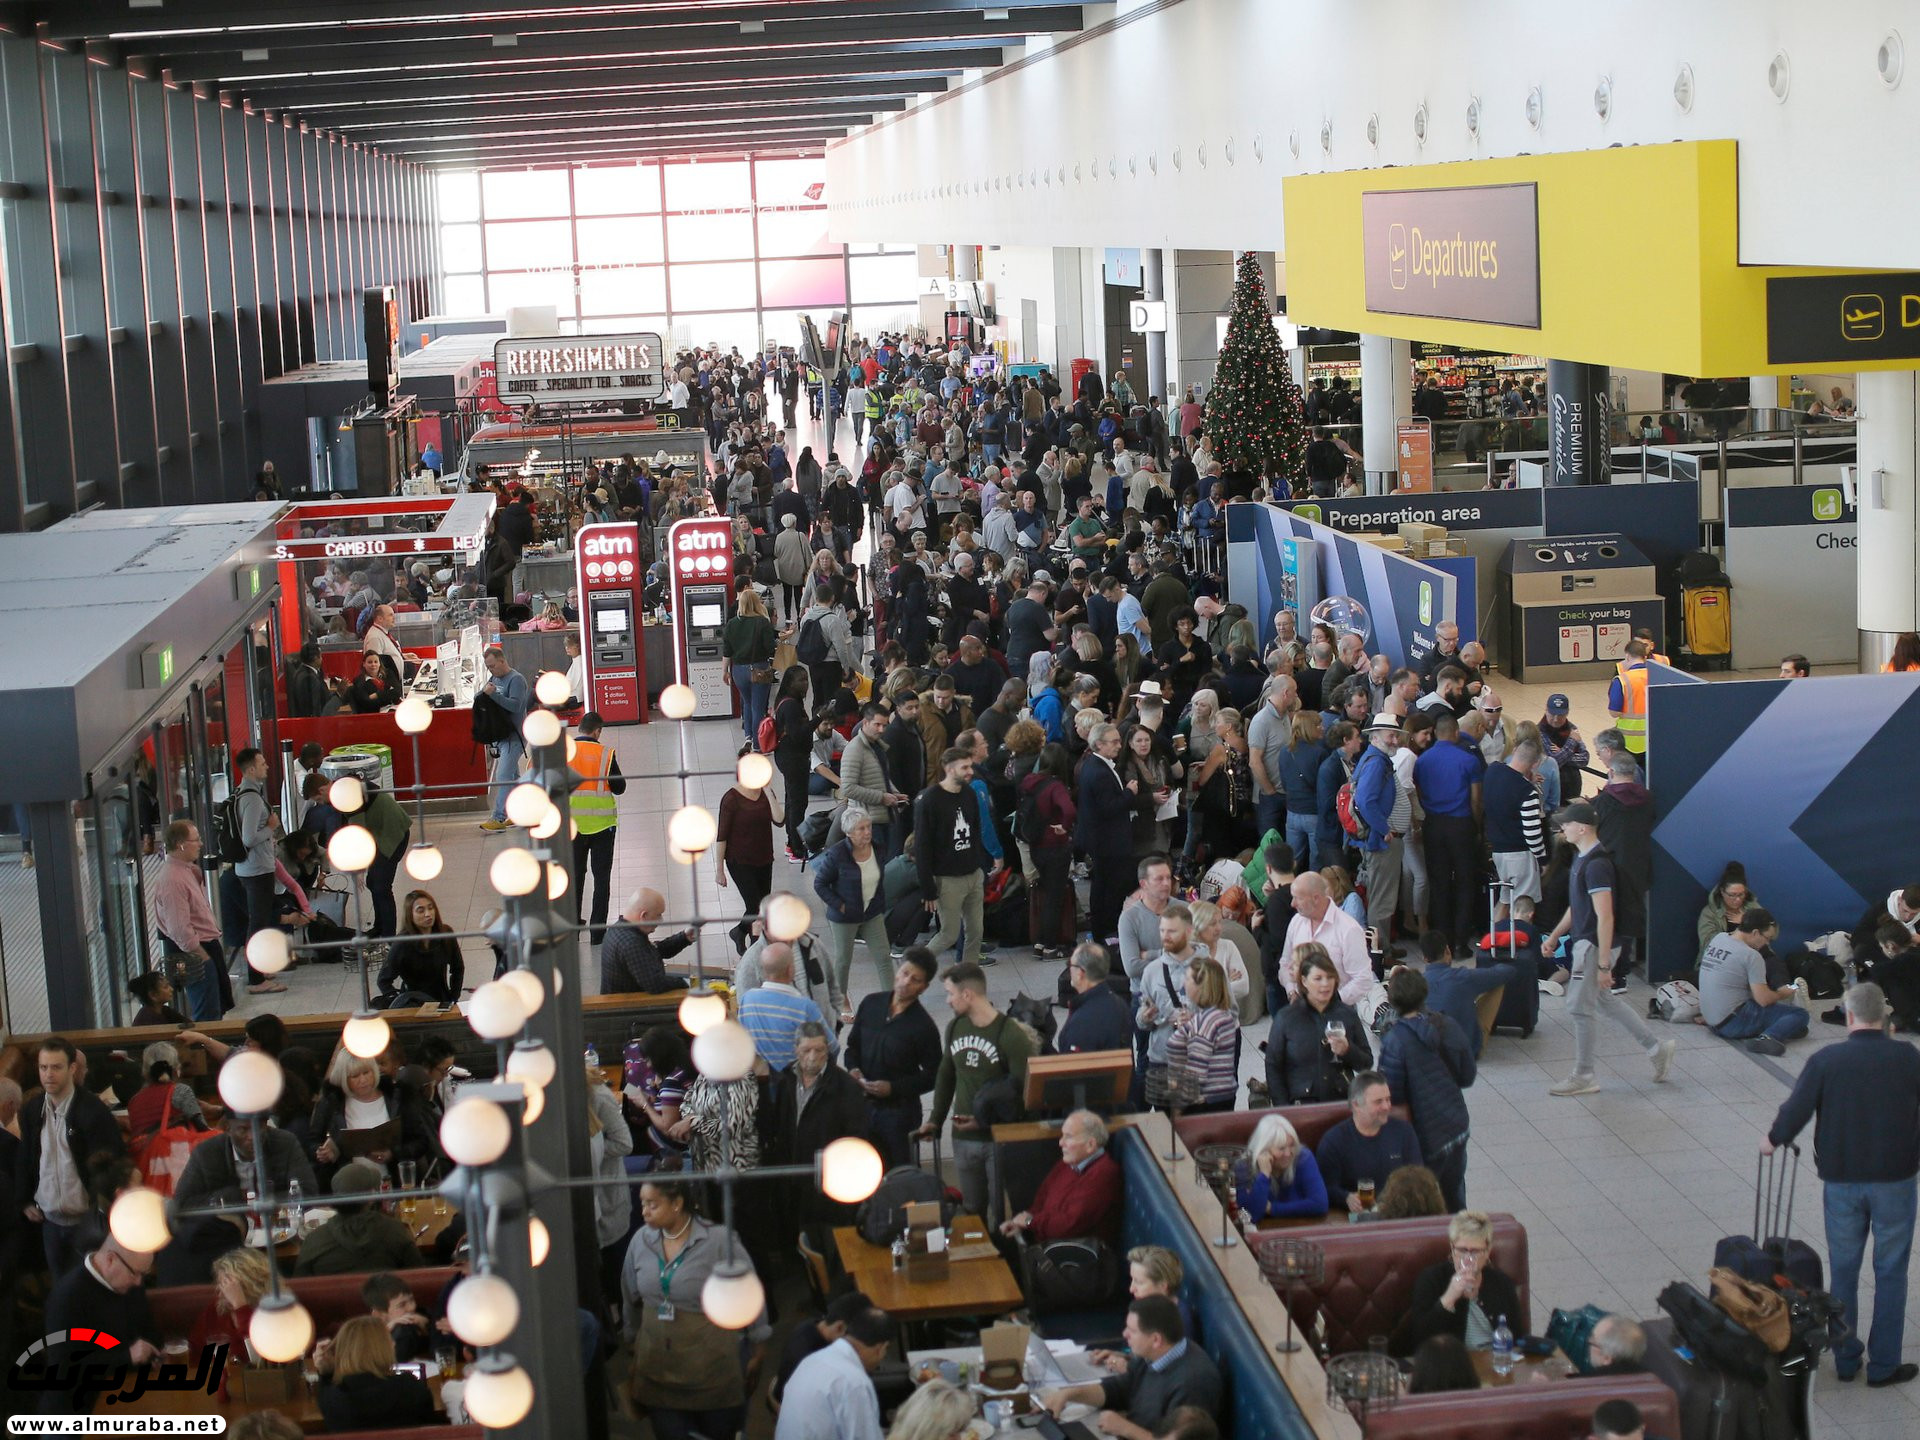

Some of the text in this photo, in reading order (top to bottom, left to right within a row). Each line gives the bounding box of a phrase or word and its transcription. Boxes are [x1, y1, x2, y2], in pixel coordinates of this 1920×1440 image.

[1411, 227, 1498, 289] Departures
[929, 278, 940, 292] A
[948, 284, 958, 298] B
[1134, 306, 1148, 328] D
[506, 344, 651, 375] REFRESHMENTS
[508, 374, 652, 393] COFFEE SPECIALITY TEA SNACKS
[1551, 393, 1568, 482] Gatwick
[1570, 402, 1583, 475] PREMIUM
[1329, 506, 1481, 530] Preparation area
[325, 540, 386, 557] CAMBIO
[584, 535, 633, 556] atm
[678, 529, 726, 551] atm
[1558, 607, 1631, 621] Check your bag
[965, 1051, 979, 1068] 92
